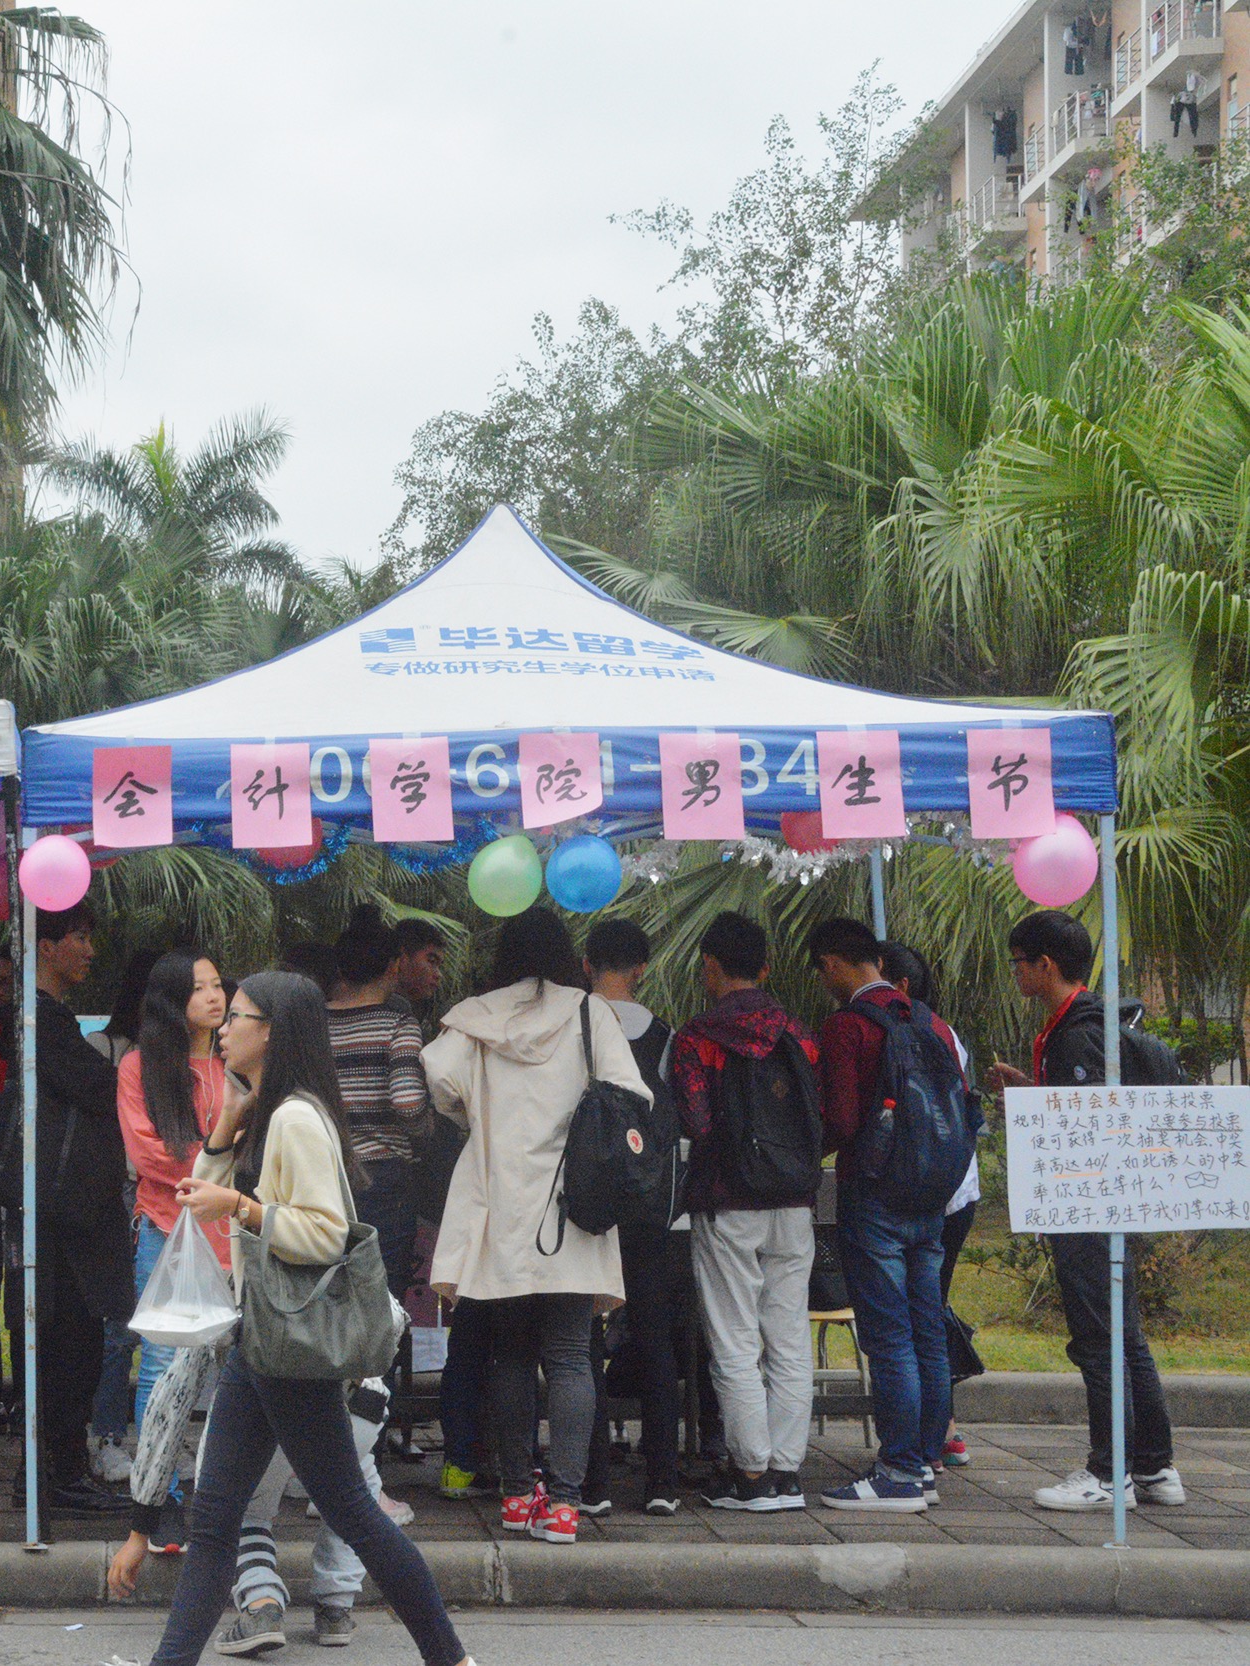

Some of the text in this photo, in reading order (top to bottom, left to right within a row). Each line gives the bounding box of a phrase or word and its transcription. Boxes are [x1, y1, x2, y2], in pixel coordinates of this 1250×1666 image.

[439, 626, 705, 661] 毕达留学
[364, 660, 717, 682] 专做研究生学位申请
[1046, 1089, 1216, 1112] 情诗会友等你来投票
